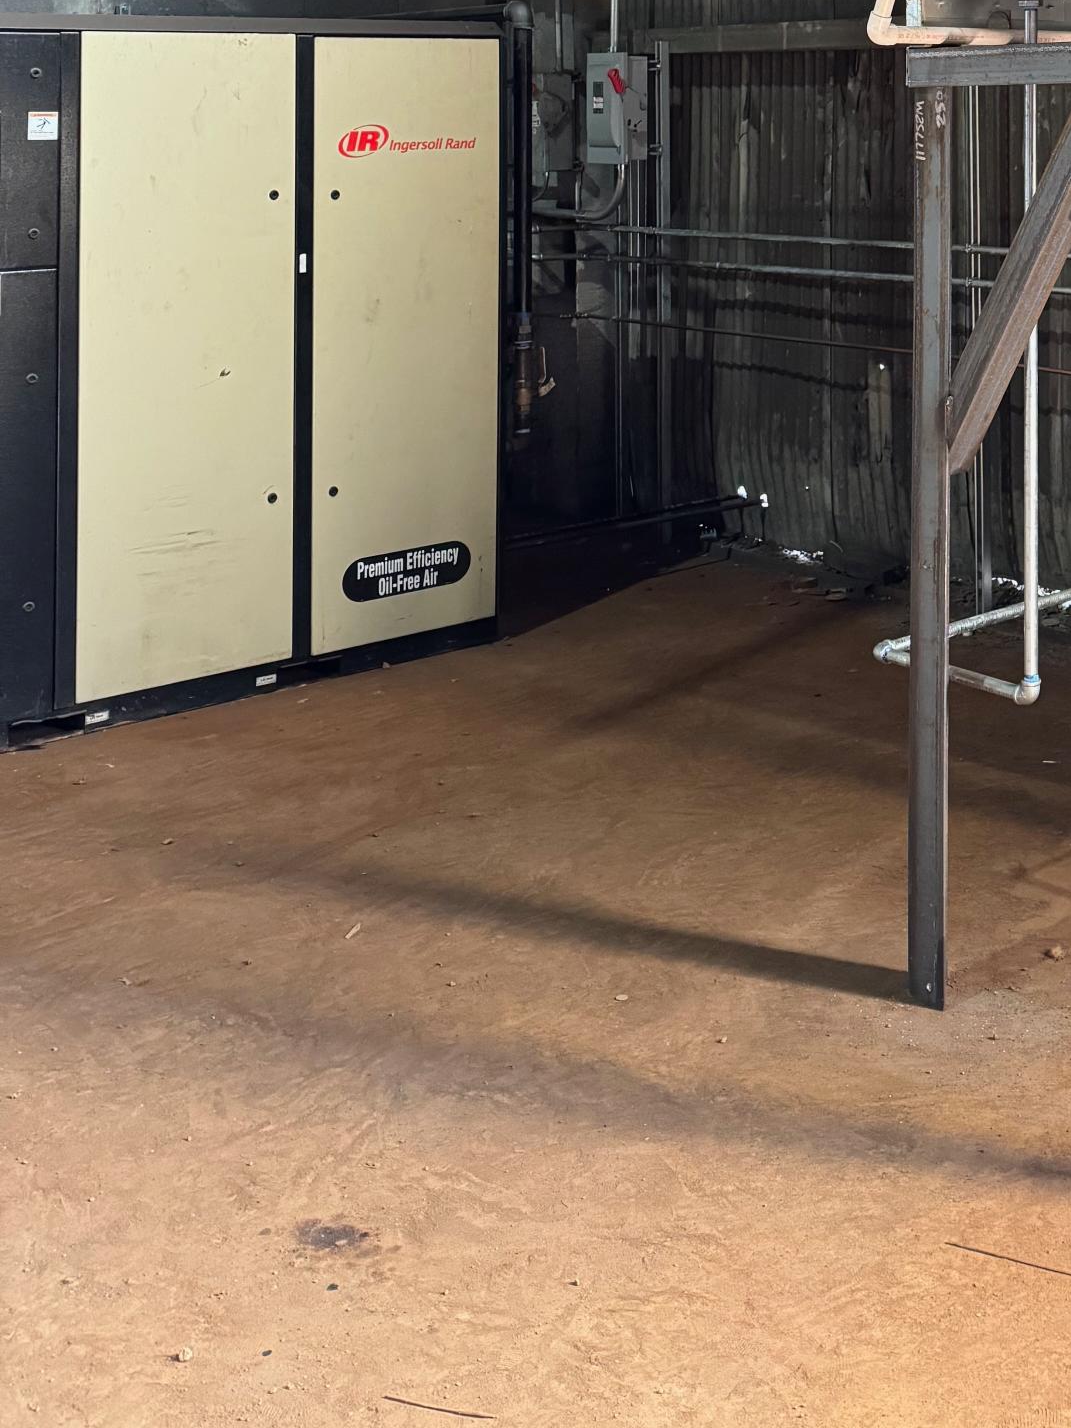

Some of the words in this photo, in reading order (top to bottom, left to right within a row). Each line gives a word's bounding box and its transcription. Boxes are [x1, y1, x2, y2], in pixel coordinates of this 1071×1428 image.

[346, 130, 382, 152] IR
[389, 138, 443, 154] Ingersoll
[444, 137, 477, 150] Rand
[356, 556, 404, 580] Premium
[406, 547, 459, 570] Efficiency
[378, 573, 421, 596] Oil-Free
[422, 568, 439, 587] Air
